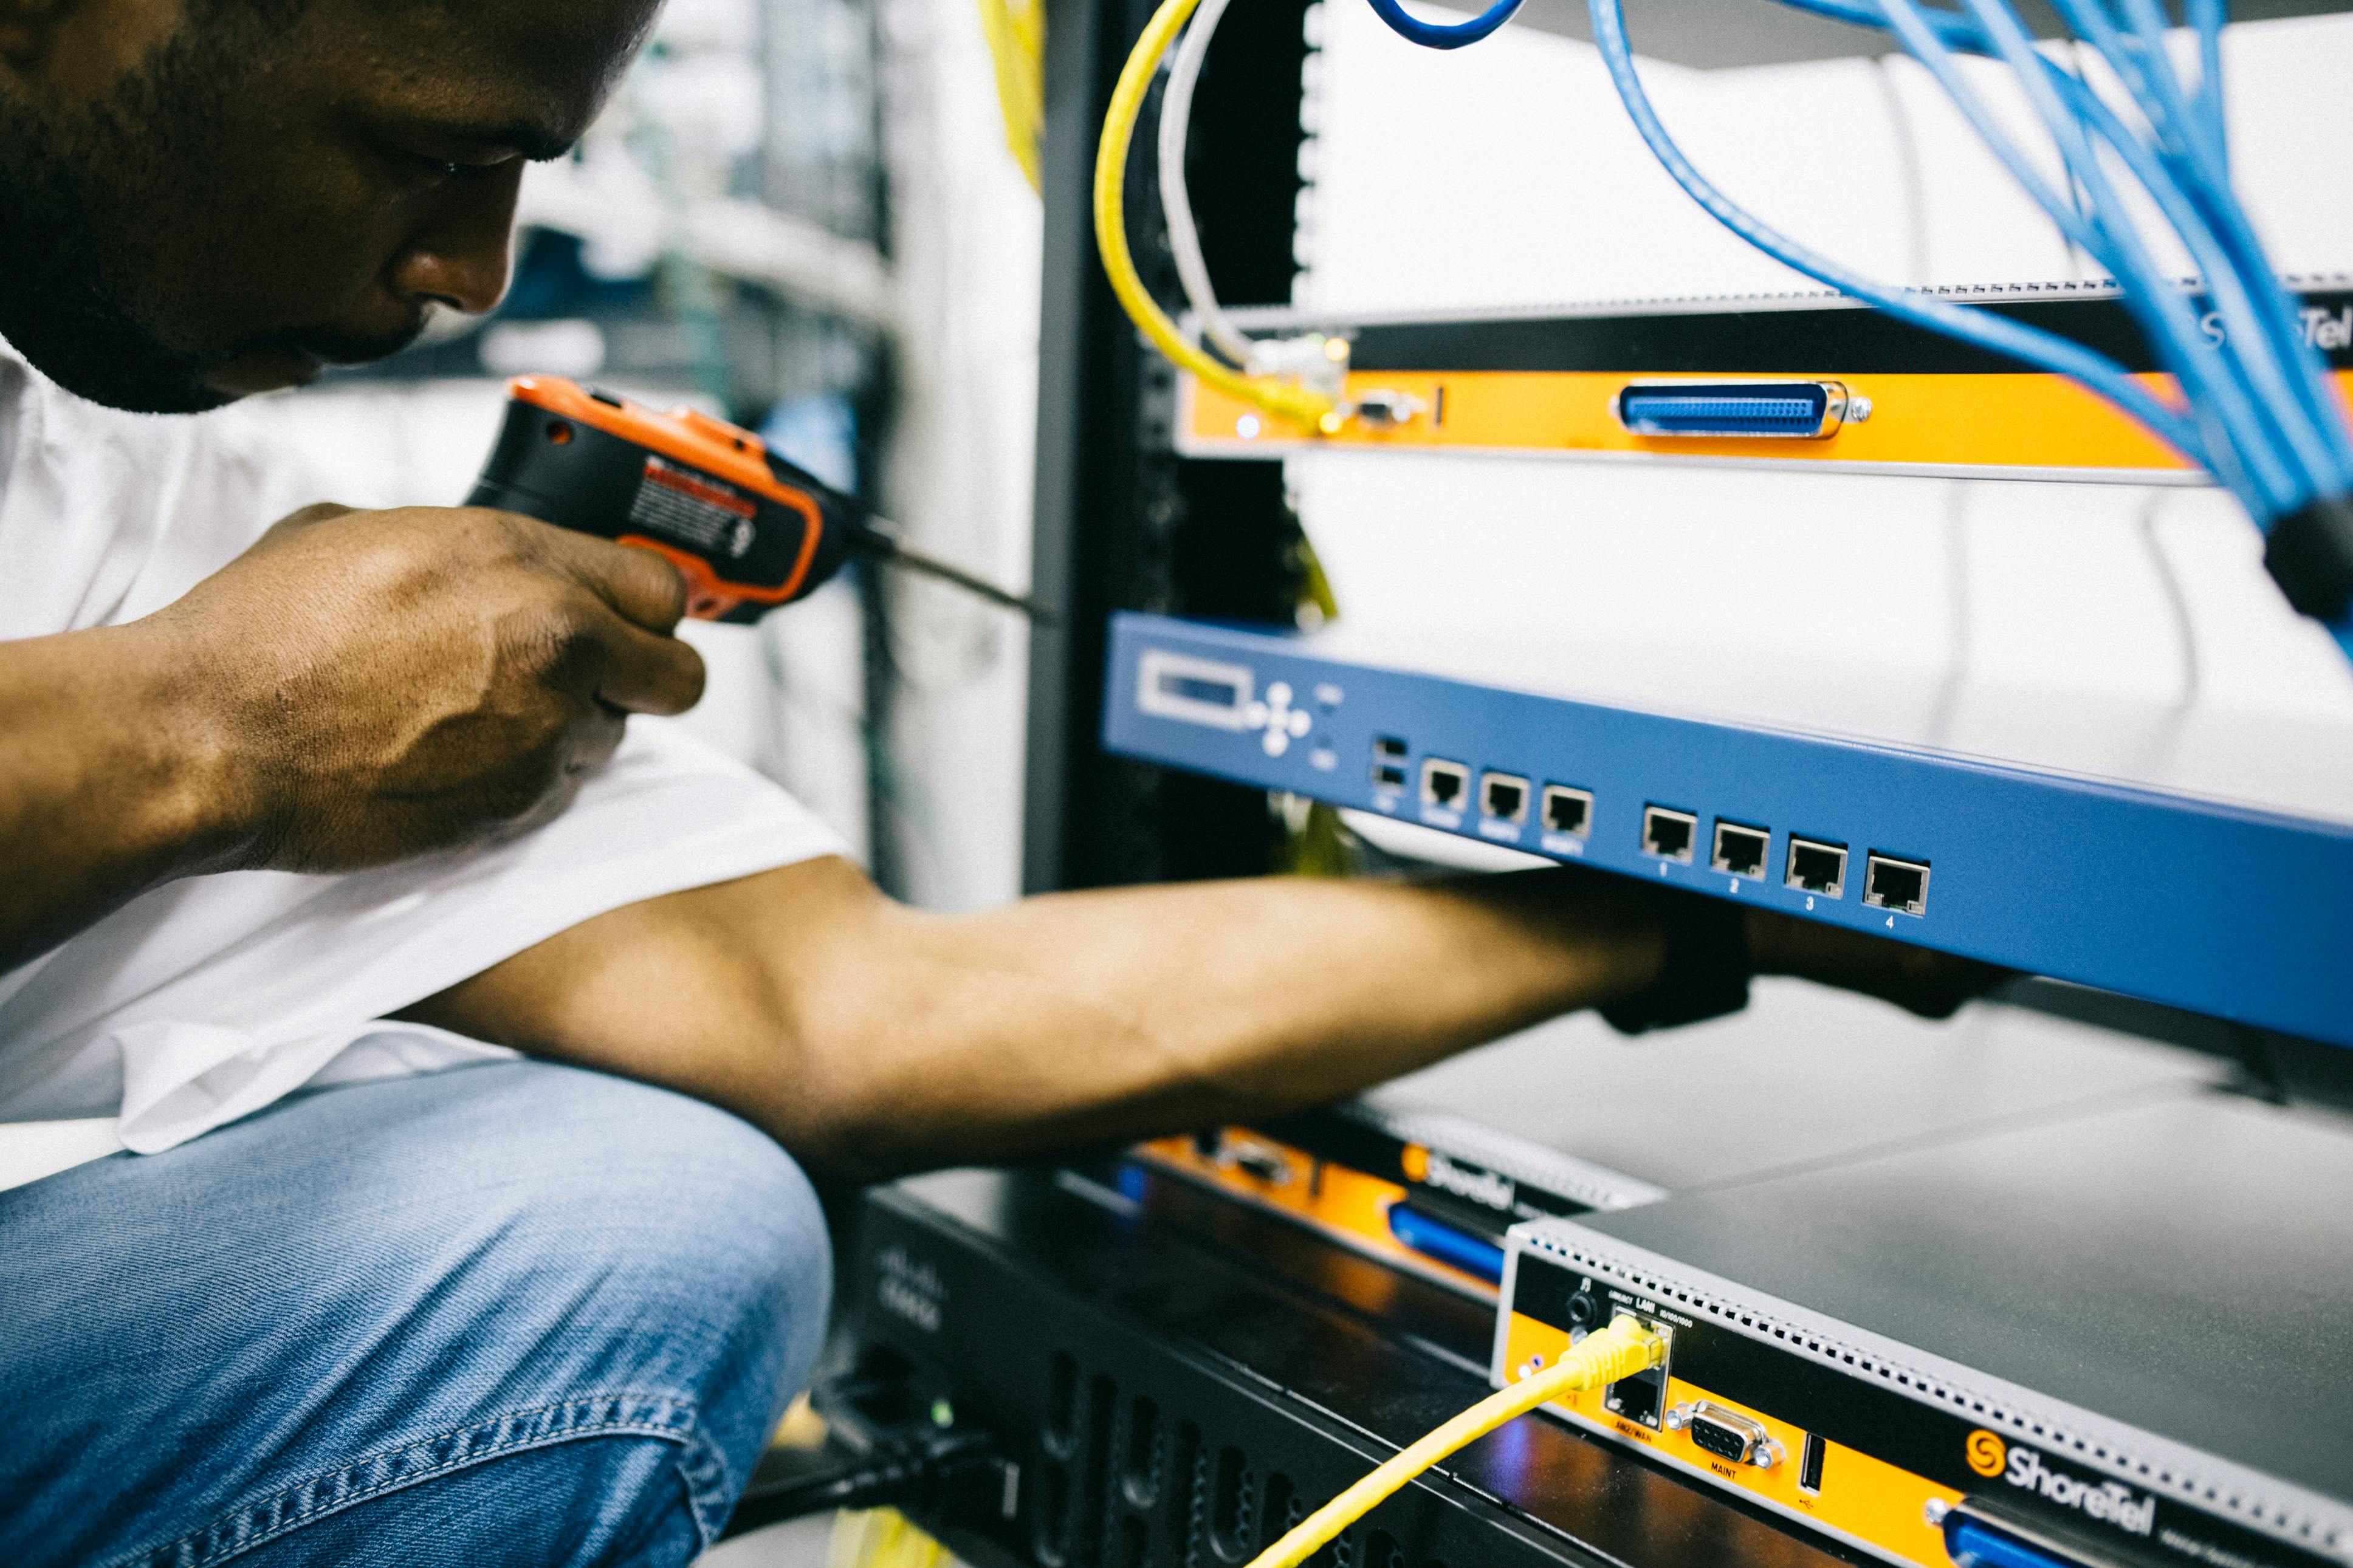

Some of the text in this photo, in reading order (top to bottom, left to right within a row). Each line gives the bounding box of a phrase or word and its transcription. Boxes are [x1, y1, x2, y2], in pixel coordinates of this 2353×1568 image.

[2201, 306, 2352, 349] STel
[1660, 861, 1894, 929] 1 2 3 4
[1660, 1309, 1692, 1328] 10/100/1000
[1711, 1462, 1736, 1479] MAINT
[2005, 1447, 2155, 1536] ShoreTel
